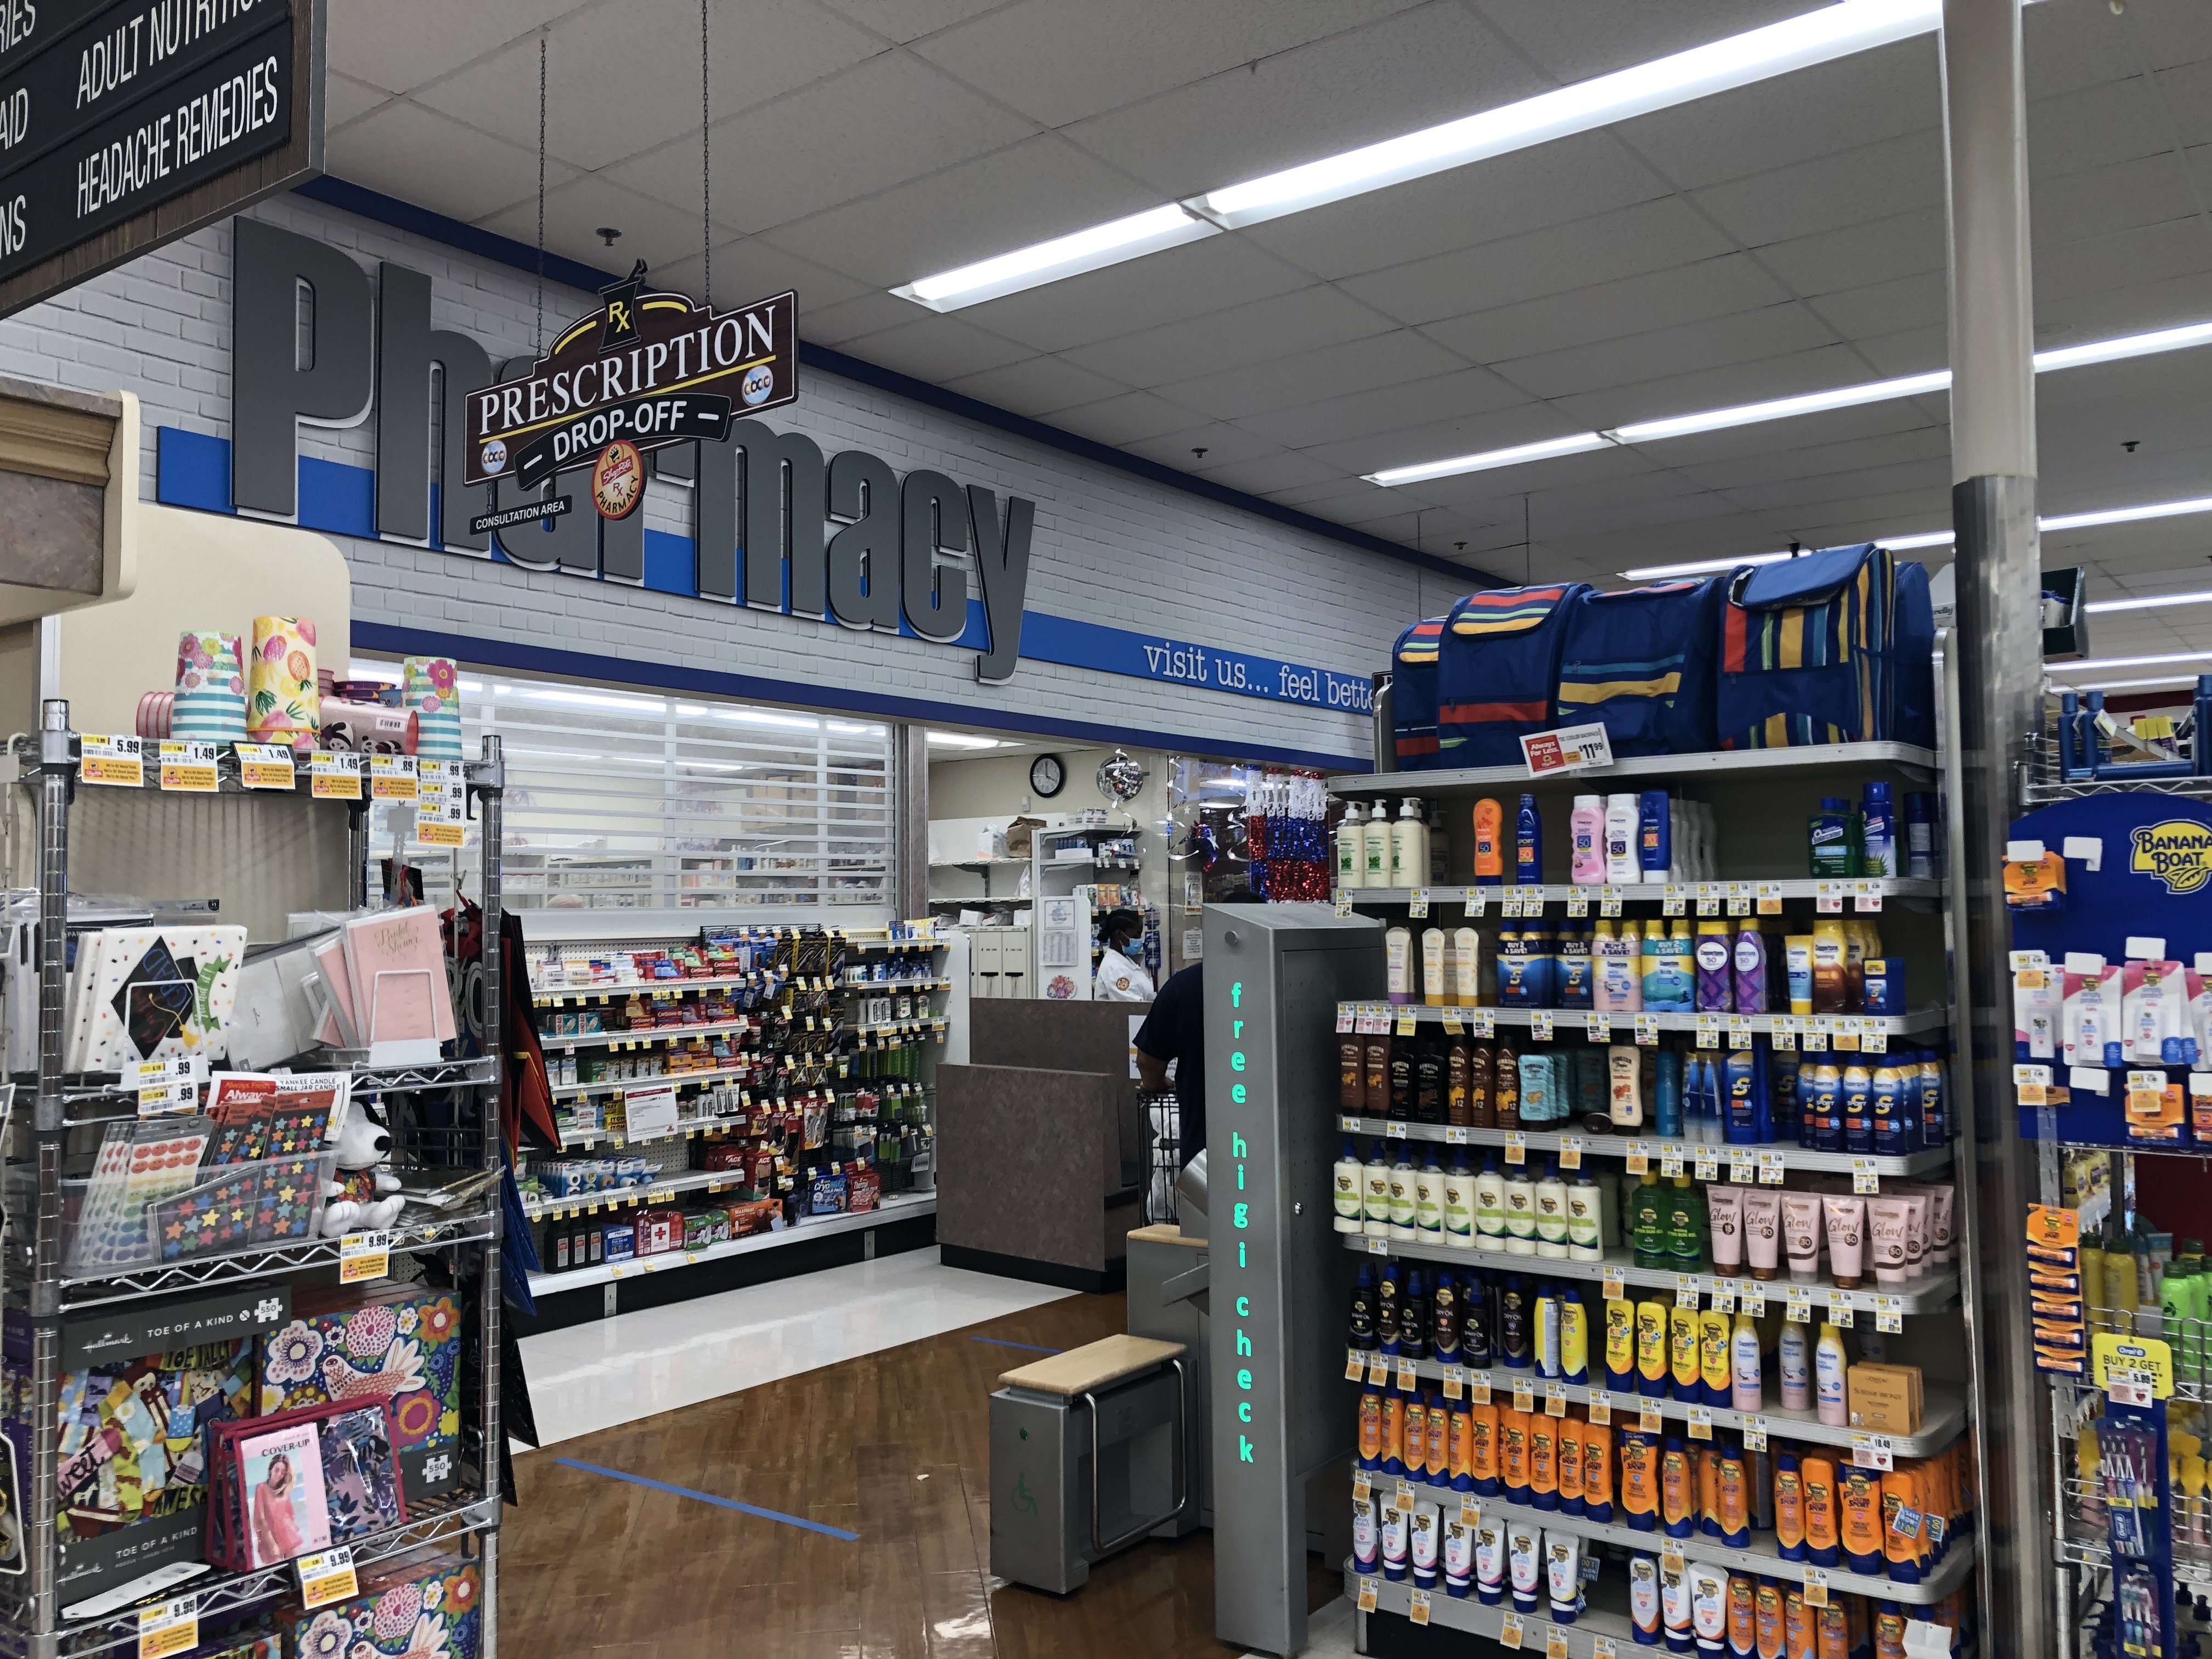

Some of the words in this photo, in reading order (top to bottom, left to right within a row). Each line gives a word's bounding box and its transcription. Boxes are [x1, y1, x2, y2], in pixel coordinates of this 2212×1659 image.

[76, 15, 144, 109] ADULT
[149, 0, 262, 65] NUTRI
[77, 115, 171, 218] HEADACHE
[176, 56, 278, 168] REMEDIES
[479, 306, 775, 436] PRESCRIPTION
[554, 400, 687, 461] DROP-OFF
[603, 459, 631, 484] ShopRite
[596, 475, 639, 514] PHARMACY
[476, 506, 539, 530] CONSULTATION
[541, 500, 565, 518] AREA
[1143, 642, 1207, 682] visit
[1279, 665, 1320, 702] feel
[117, 740, 139, 753] 5.99
[194, 747, 215, 760] 1.49
[268, 749, 289, 759] 1.49
[340, 758, 358, 770] 1.49
[1612, 845, 1624, 853] 50
[2136, 831, 2212, 853] BANANA
[2152, 850, 2203, 876] BOAT
[1231, 981, 1247, 1104] free
[176, 1061, 190, 1075] .99
[178, 1087, 193, 1101] .99
[1232, 1131, 1249, 1268] higi
[1710, 1208, 1737, 1222] Glow
[1746, 1211, 1776, 1226] Glow
[1784, 1215, 1814, 1229] Glow
[1828, 1217, 1860, 1233] Glow
[1872, 1222, 1904, 1238] Glow
[369, 1234, 387, 1248] 9.99
[261, 1304, 276, 1314] 550
[147, 1327, 170, 1338] TOE
[174, 1323, 189, 1334] OF
[194, 1321, 202, 1329] A
[206, 1314, 234, 1327] KIND
[2103, 1355, 2125, 1366] BUY
[2129, 1358, 2136, 1368] 2
[2140, 1360, 2162, 1372] GET
[1235, 1296, 1254, 1463] check
[262, 1438, 310, 1458] COVER-UP
[1875, 1438, 1891, 1449] 10.49
[58, 1442, 105, 1500] weet
[429, 1462, 446, 1473] 550
[115, 1545, 138, 1559] TOE
[140, 1539, 157, 1551] OF
[160, 1536, 168, 1545] A
[172, 1526, 198, 1541] KIND
[329, 1550, 351, 1567] 9.99
